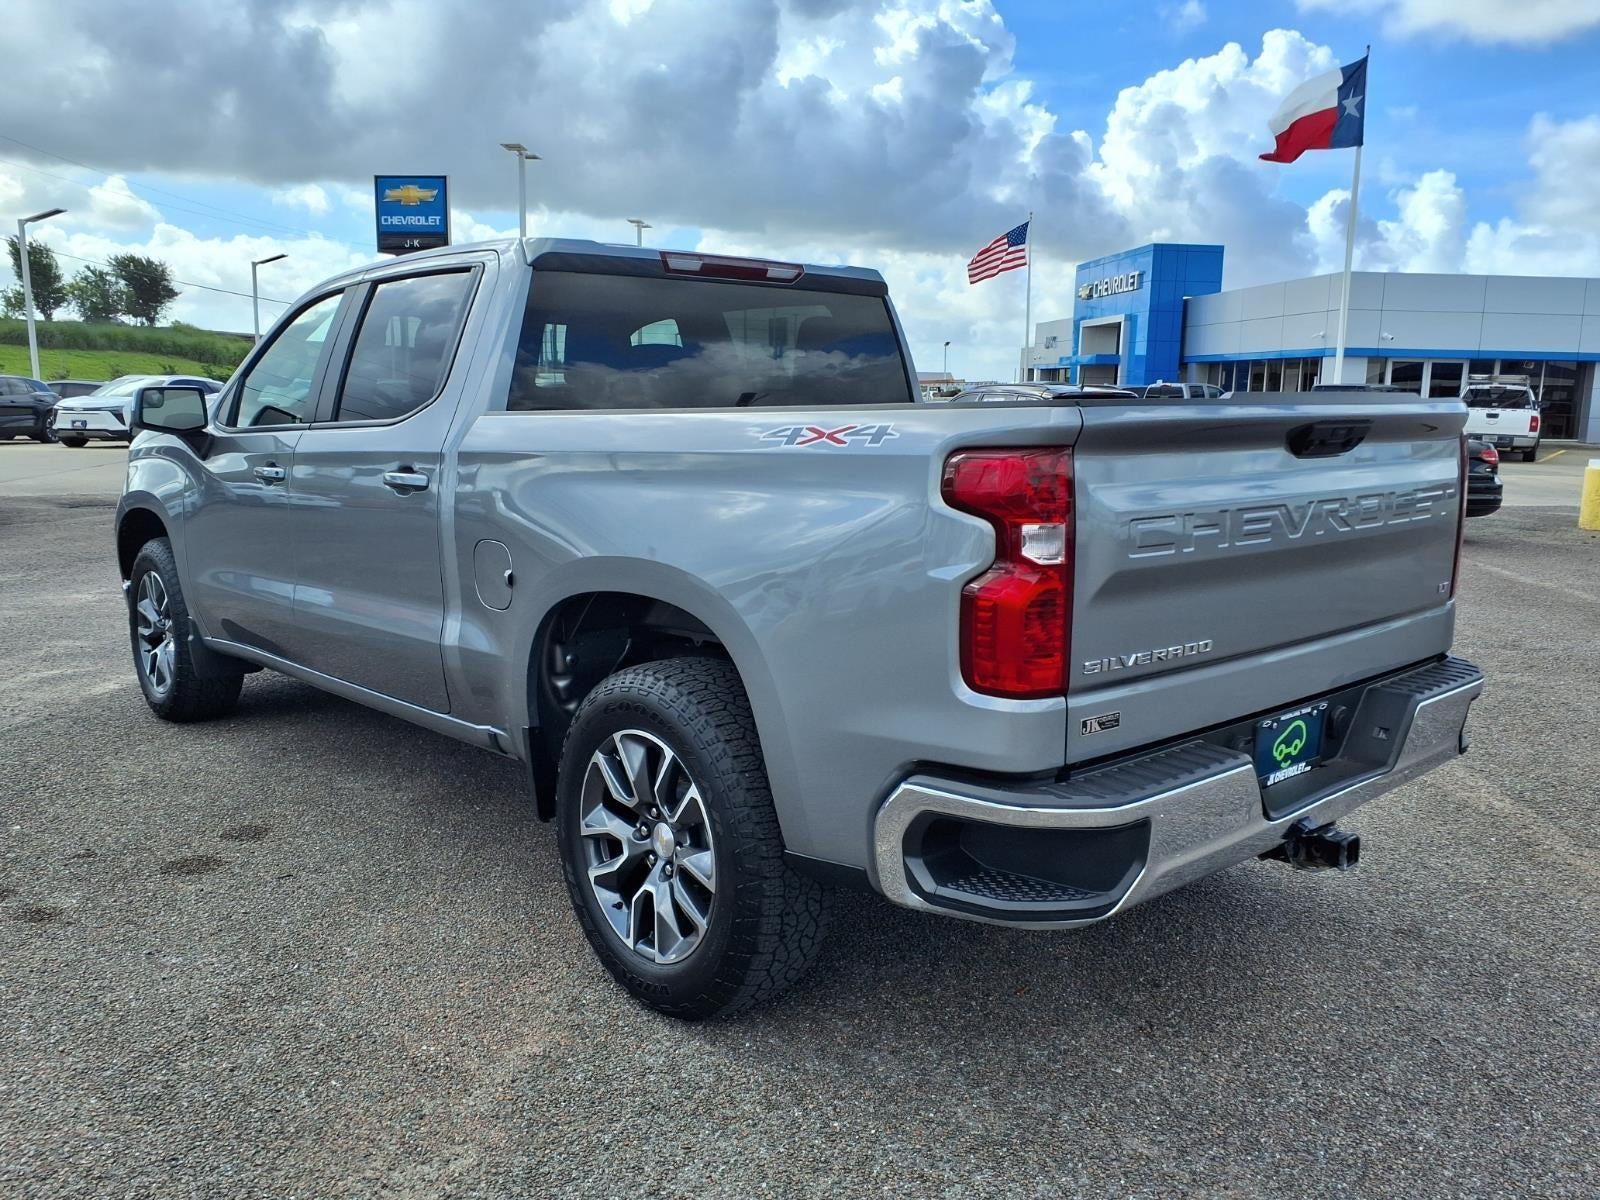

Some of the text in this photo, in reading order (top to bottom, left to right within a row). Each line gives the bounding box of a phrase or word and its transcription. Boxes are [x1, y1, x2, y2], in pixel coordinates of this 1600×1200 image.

[381, 215, 441, 226] CHEVROLET
[404, 239, 420, 248] J-K
[1093, 271, 1140, 298] CHEVROLET
[1128, 486, 1455, 559] CHEVROLET
[1083, 639, 1213, 675] SILVERADO
